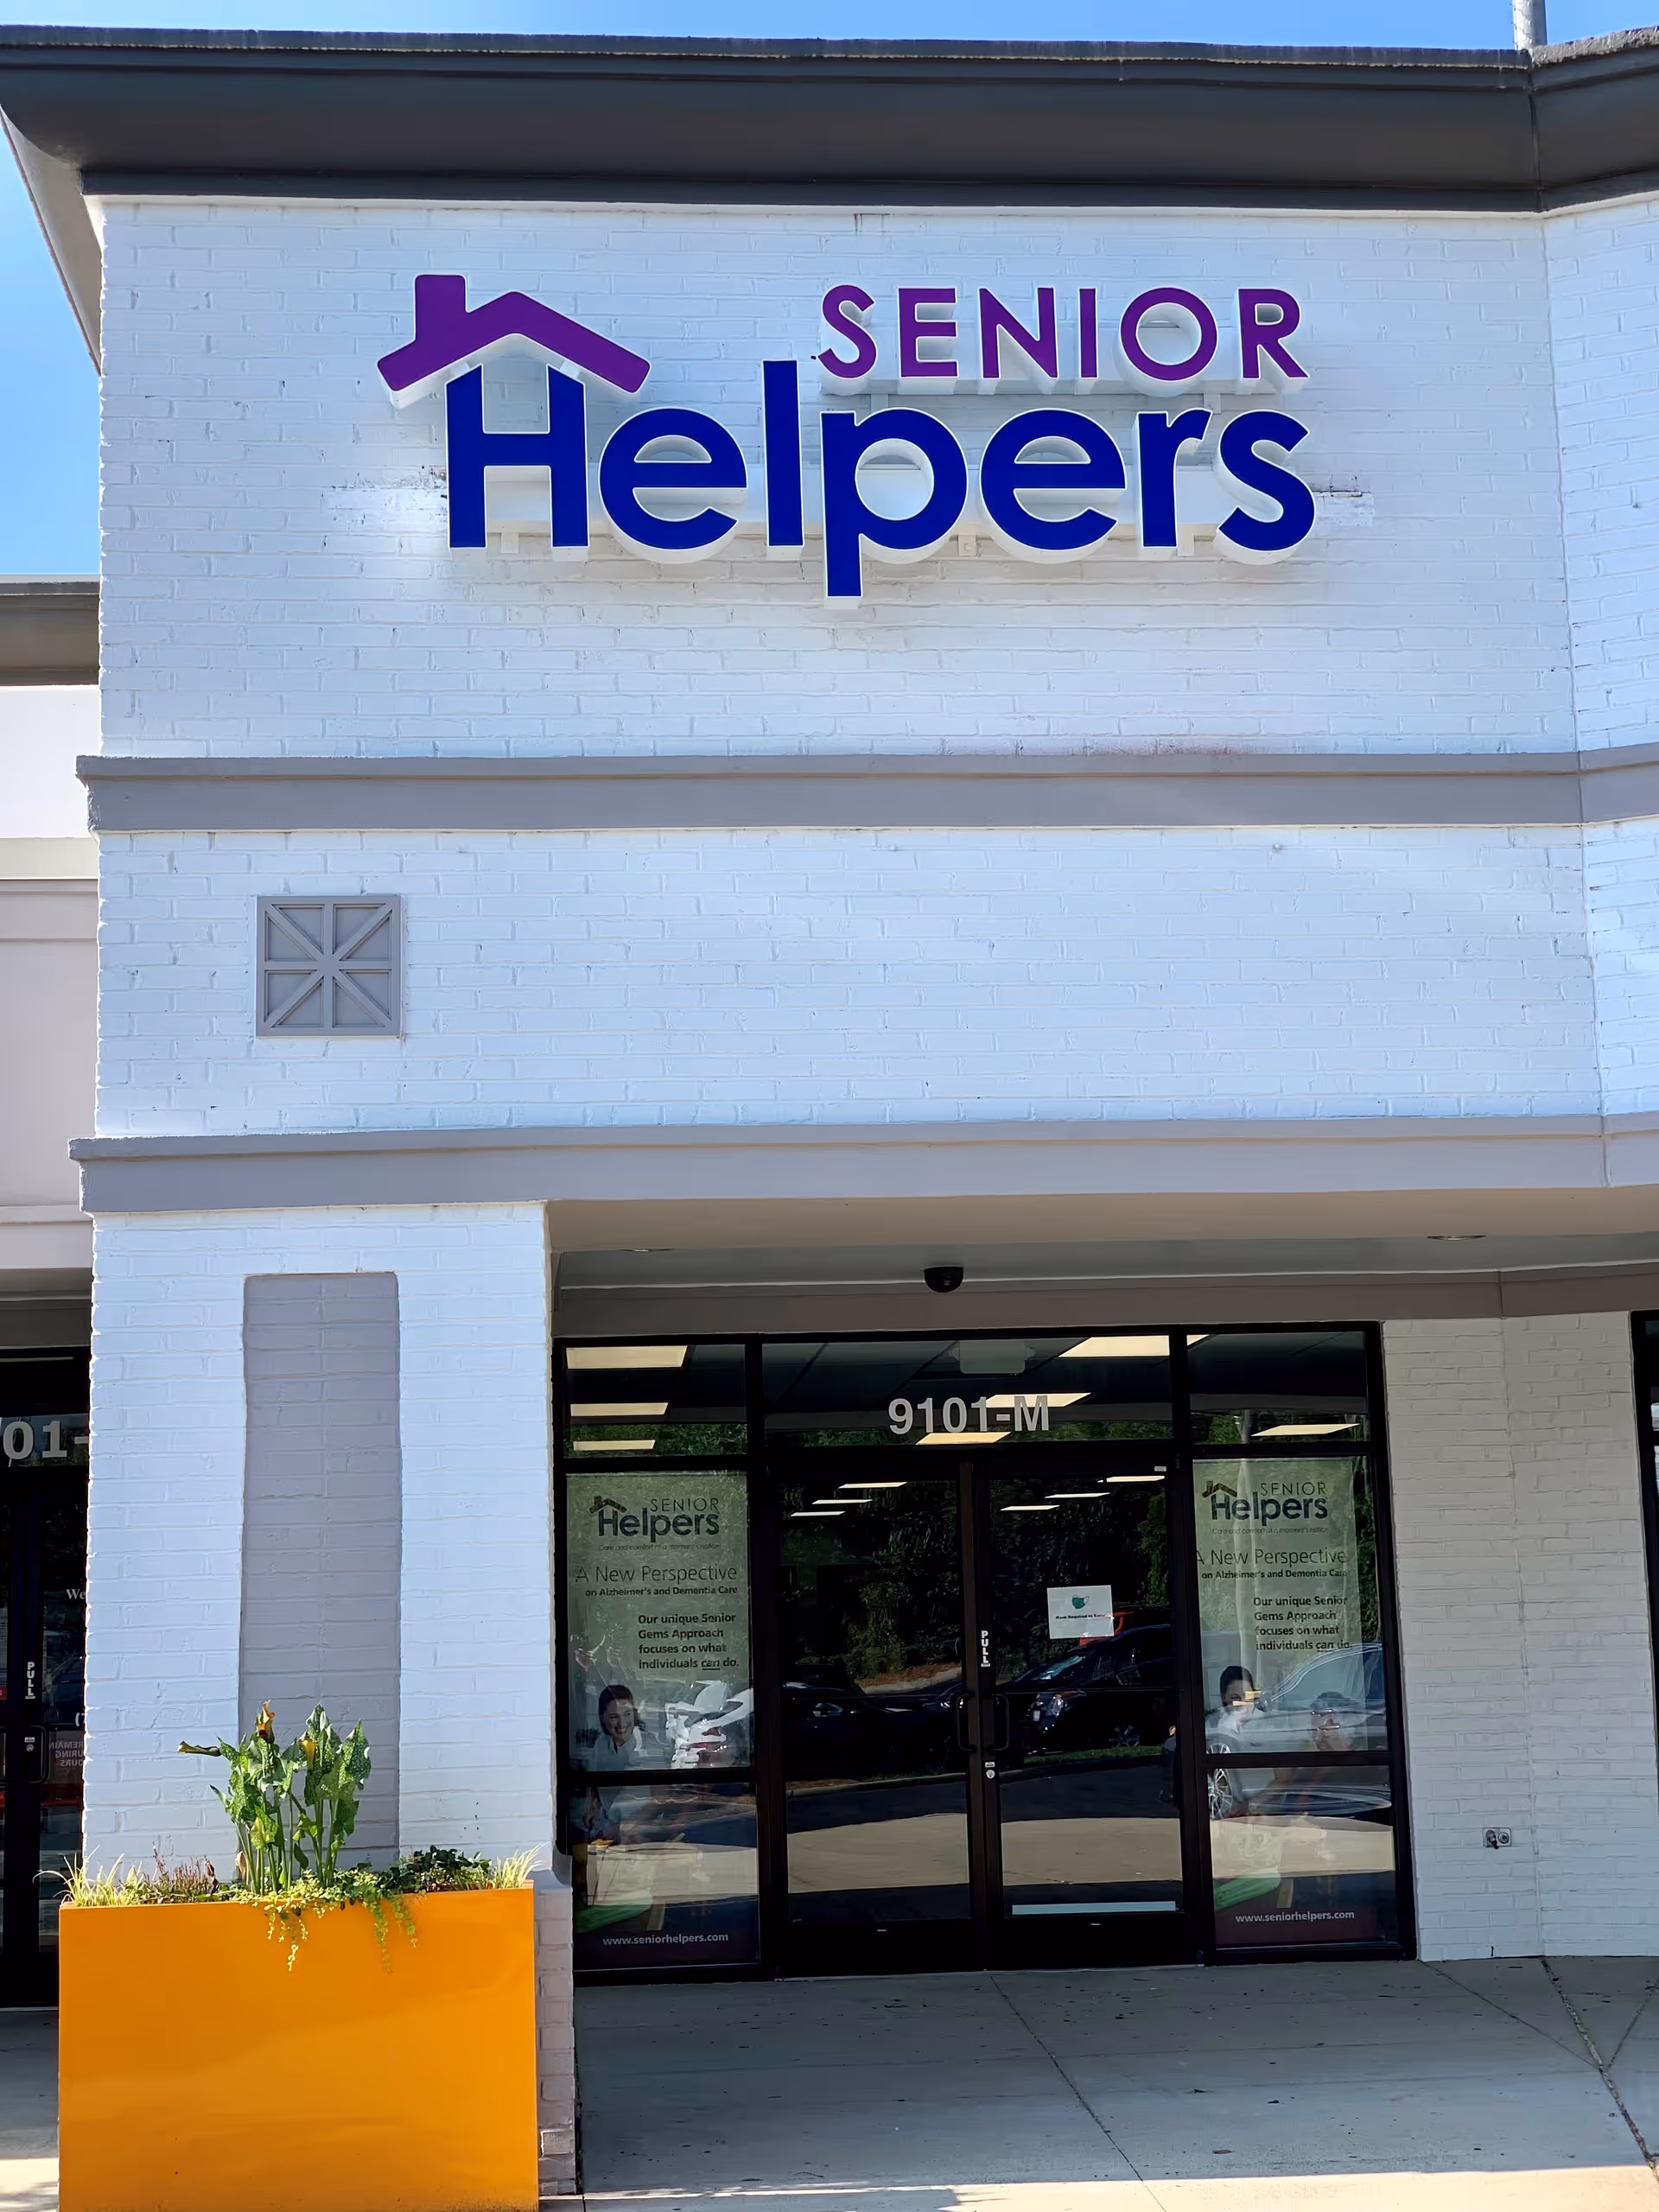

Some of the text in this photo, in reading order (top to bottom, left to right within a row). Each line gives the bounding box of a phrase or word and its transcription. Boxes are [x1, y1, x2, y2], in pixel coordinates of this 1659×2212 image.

[816, 284, 1309, 382] SENIOR
[443, 359, 1318, 598] Helpers
[888, 1395, 1050, 1435] 9101-M
[1260, 1481, 1327, 1496] SENIOR
[650, 1497, 720, 1512] SENIOR
[1211, 1491, 1329, 1527] Helpers
[598, 1508, 720, 1543] Helpers
[1211, 1549, 1249, 1565] New
[1255, 1547, 1347, 1567] Perspective
[575, 1564, 737, 1585] A New Perspective
[1215, 1570, 1265, 1580] Alzheimer's
[1267, 1569, 1283, 1578] and
[1285, 1569, 1327, 1578] Dementia
[1329, 1568, 1348, 1577] Care
[585, 1586, 738, 1597] on Alzheimer's and Dementia Care
[1253, 1595, 1348, 1607] Our unique Senior
[638, 1612, 736, 1625] Our unique Senior
[1254, 1610, 1337, 1623] Gems Approach
[638, 1628, 723, 1640] Gems Approach
[1255, 1625, 1294, 1636] focuses
[1312, 1624, 1340, 1635] what
[638, 1644, 679, 1654] focuses
[698, 1642, 727, 1653] what
[981, 1630, 990, 1665] PULL
[1255, 1640, 1313, 1650] individuals
[1315, 1642, 1334, 1652] can
[639, 1656, 740, 1670] individuals can do.
[27, 1662, 35, 1696] PULL
[1235, 1910, 1355, 1923] www.seniorhelpers.com
[602, 1933, 729, 1946] www.seniorhelpers.com
